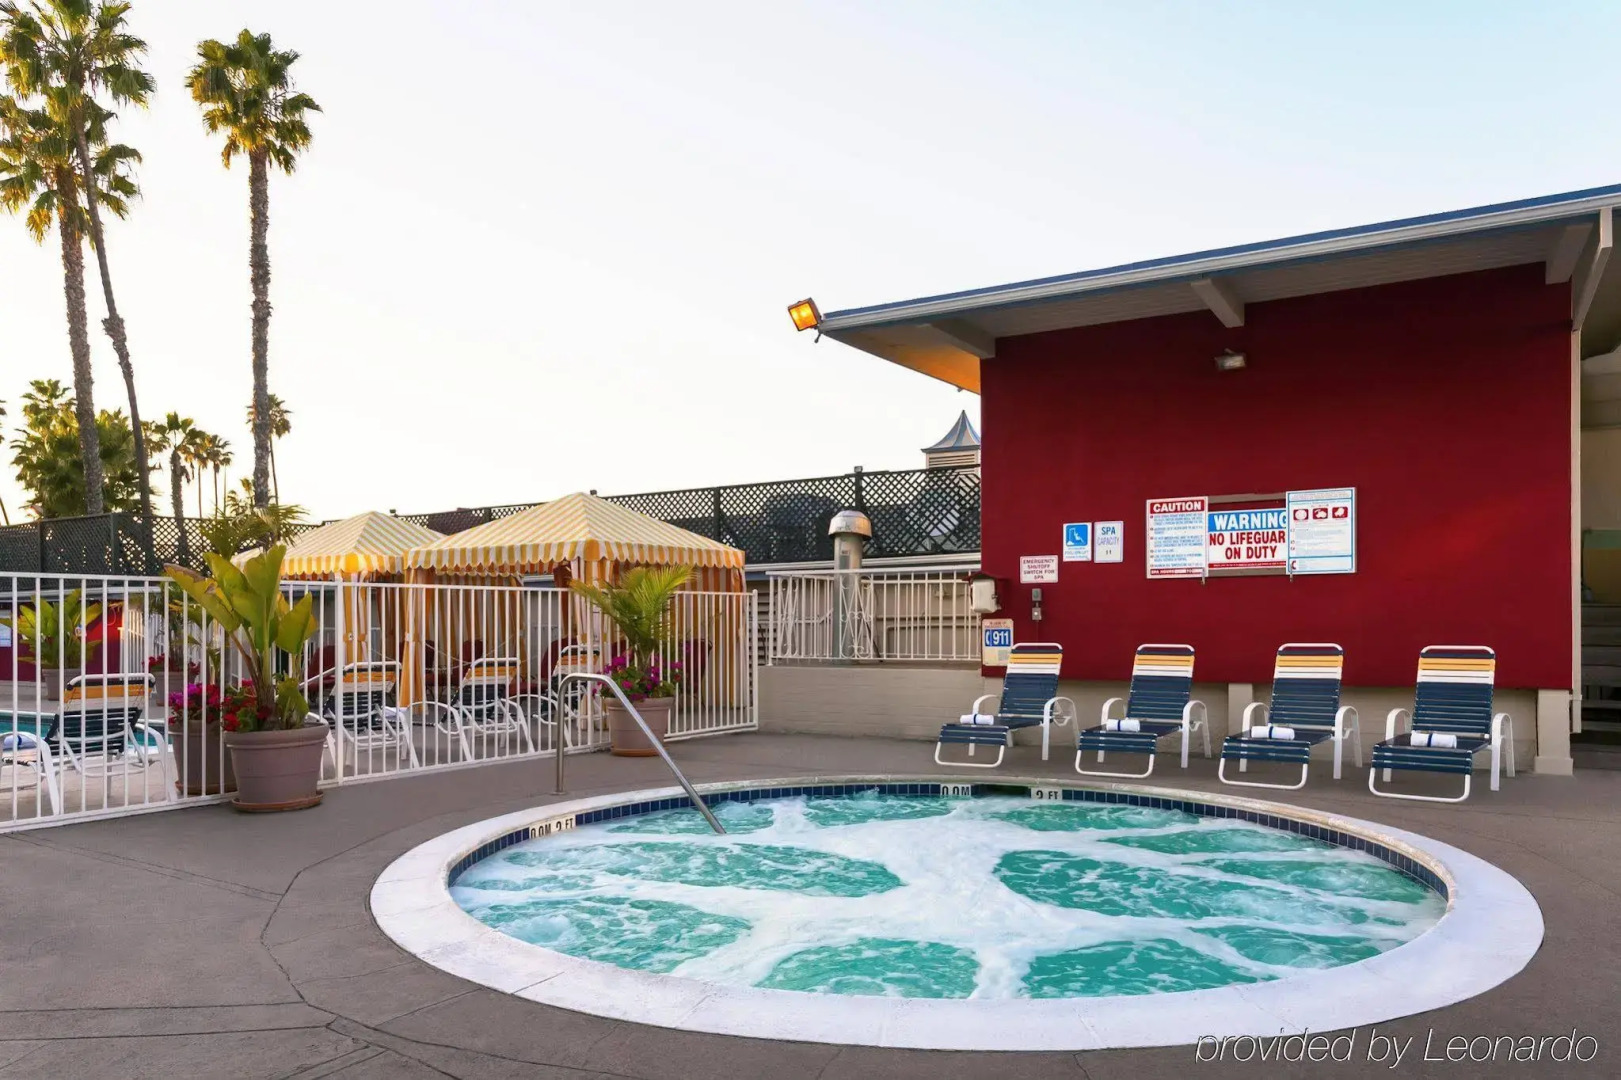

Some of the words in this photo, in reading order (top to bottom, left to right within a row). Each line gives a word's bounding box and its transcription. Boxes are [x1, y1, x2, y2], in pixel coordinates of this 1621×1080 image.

[1153, 501, 1202, 513] CAUTION
[1213, 511, 1286, 531] WARNING
[1101, 526, 1116, 535] SPA
[1209, 532, 1225, 546] NO
[1230, 530, 1286, 545] LIFEGUAR
[1225, 547, 1241, 560] ON
[1246, 546, 1278, 559] DUTY
[992, 630, 1010, 645] 911
[1048, 790, 1059, 799] FT
[565, 817, 574, 829] FT
